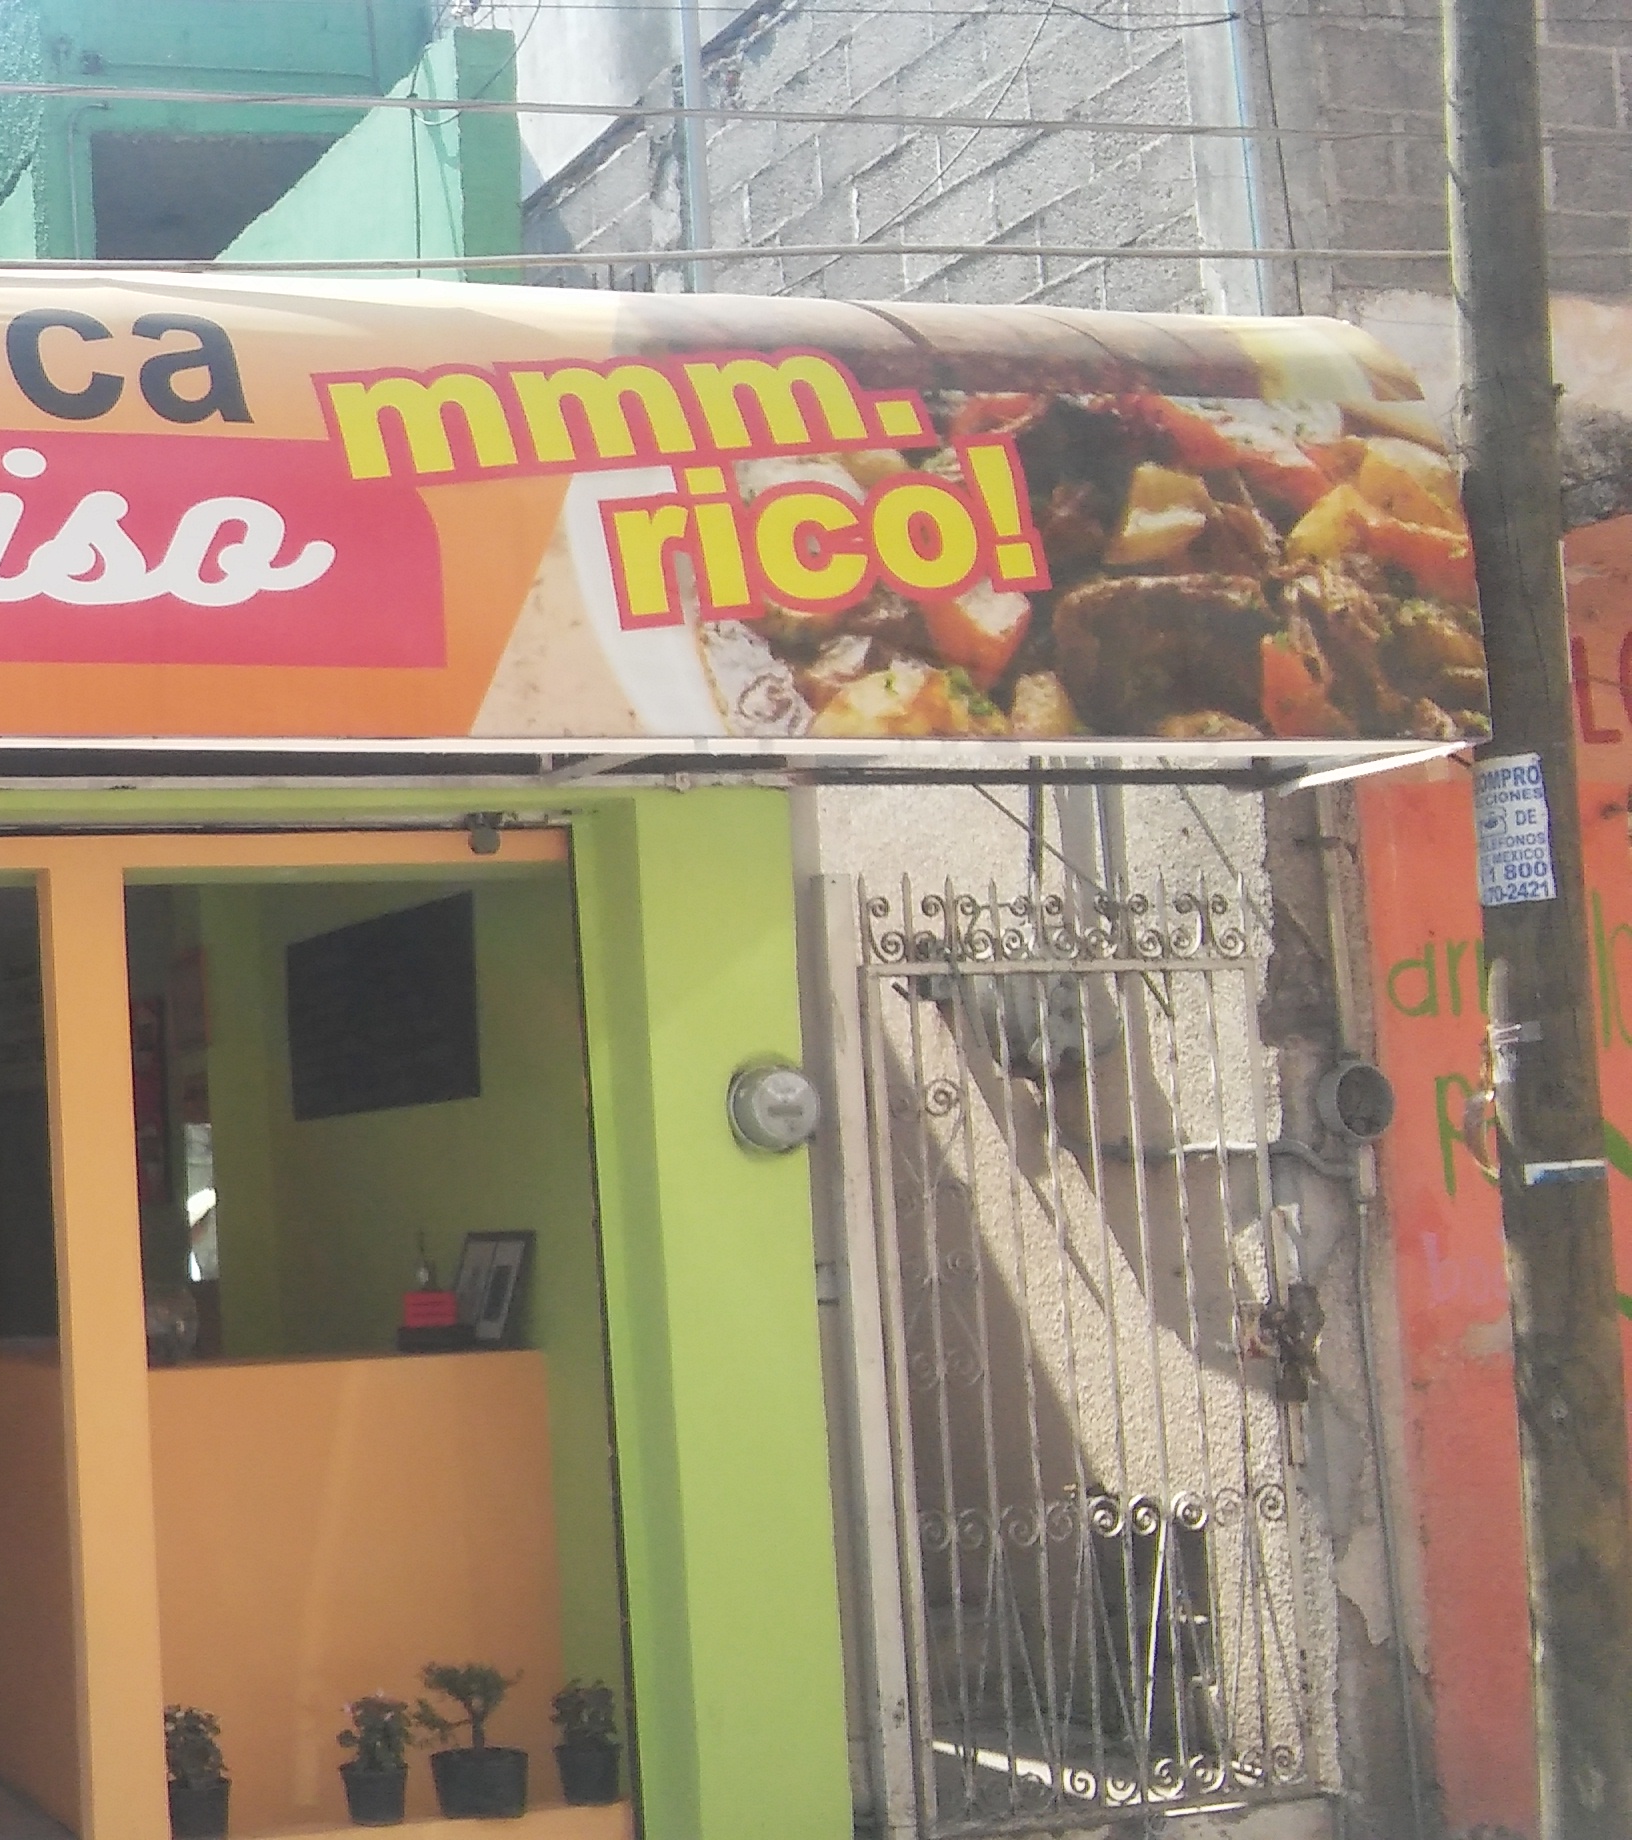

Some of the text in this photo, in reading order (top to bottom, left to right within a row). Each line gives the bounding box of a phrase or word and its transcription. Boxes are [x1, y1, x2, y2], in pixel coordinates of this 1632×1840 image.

[323, 352, 925, 482] mmm.
[611, 443, 1038, 618] rico!
[1515, 808, 1537, 826] DE
[1503, 861, 1548, 881] 800
